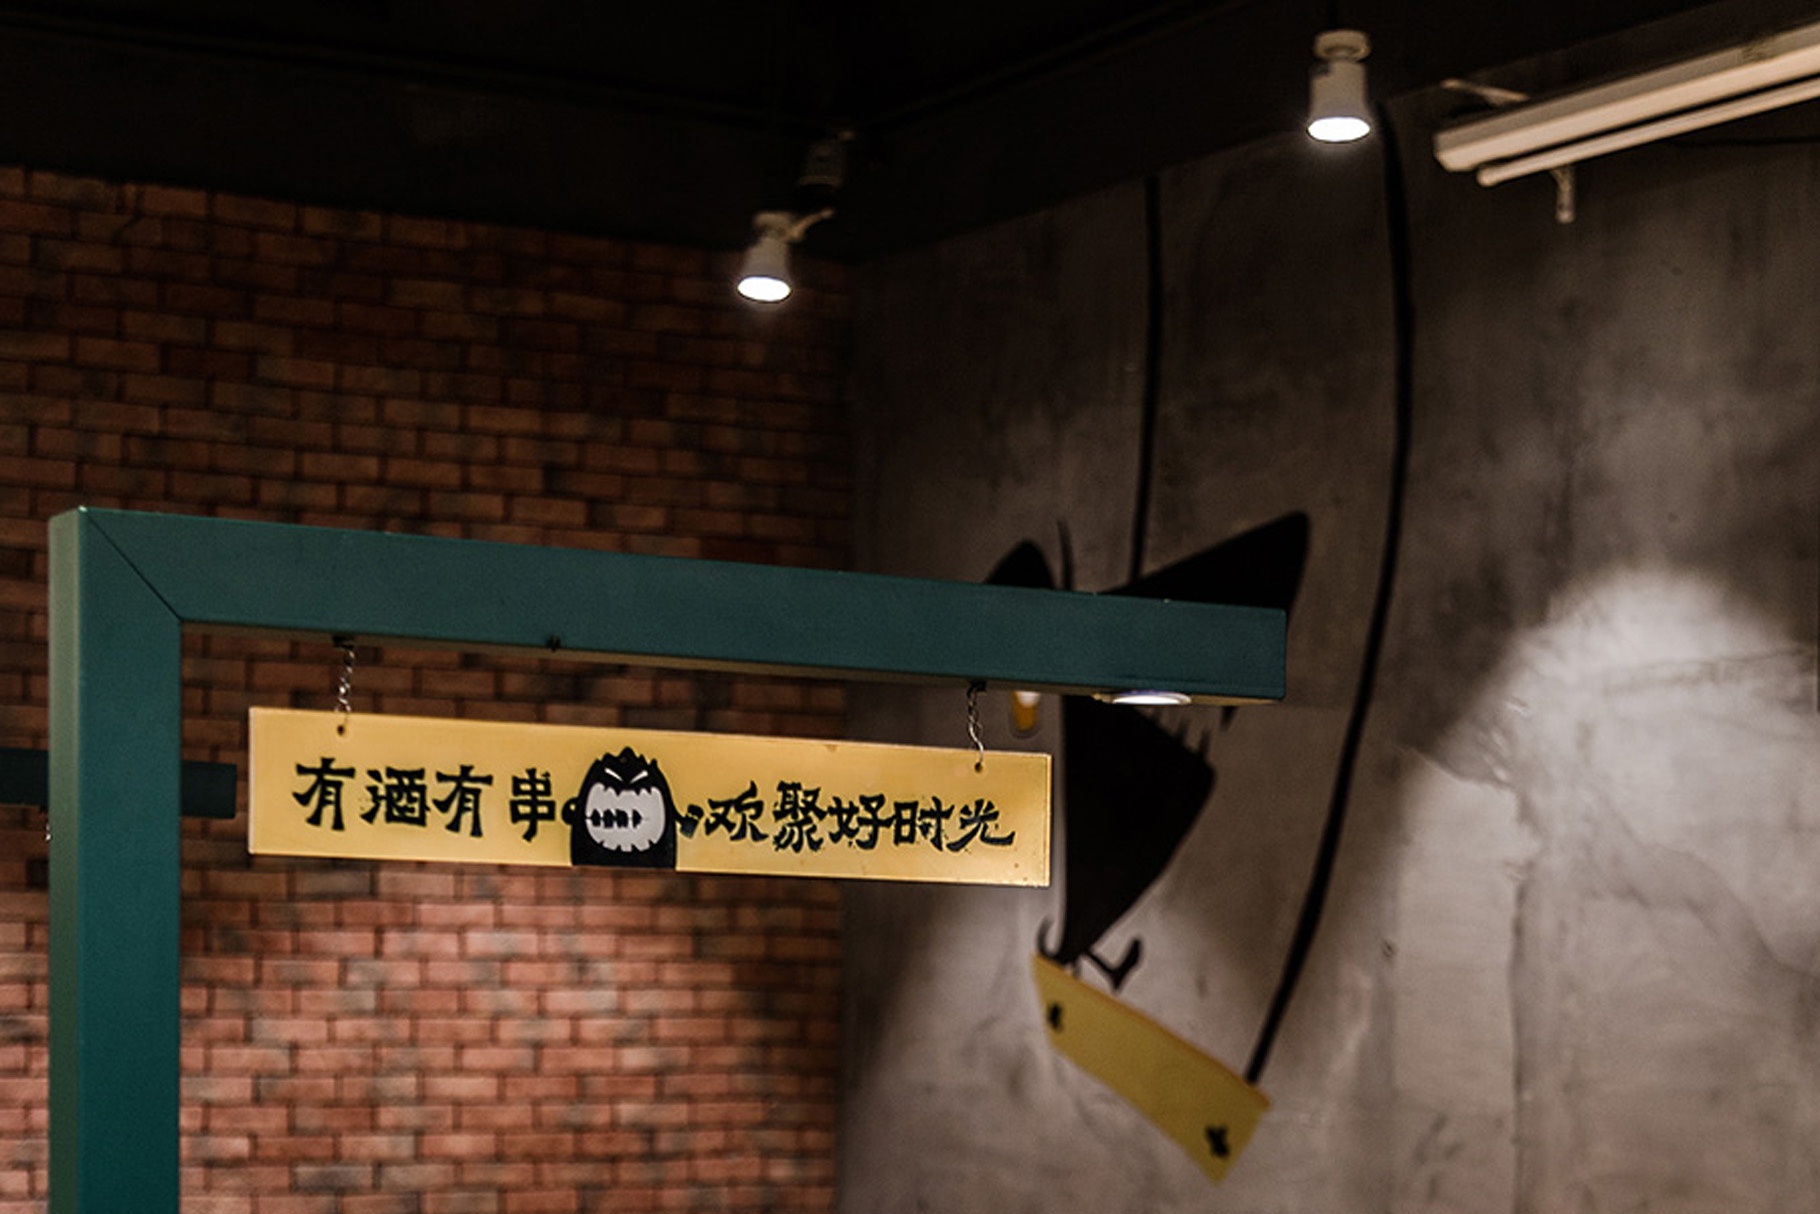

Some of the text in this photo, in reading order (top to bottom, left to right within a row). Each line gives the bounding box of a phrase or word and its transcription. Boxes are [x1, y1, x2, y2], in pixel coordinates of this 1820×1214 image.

[292, 757, 1015, 853] 有酒有串 欢聚好时光
